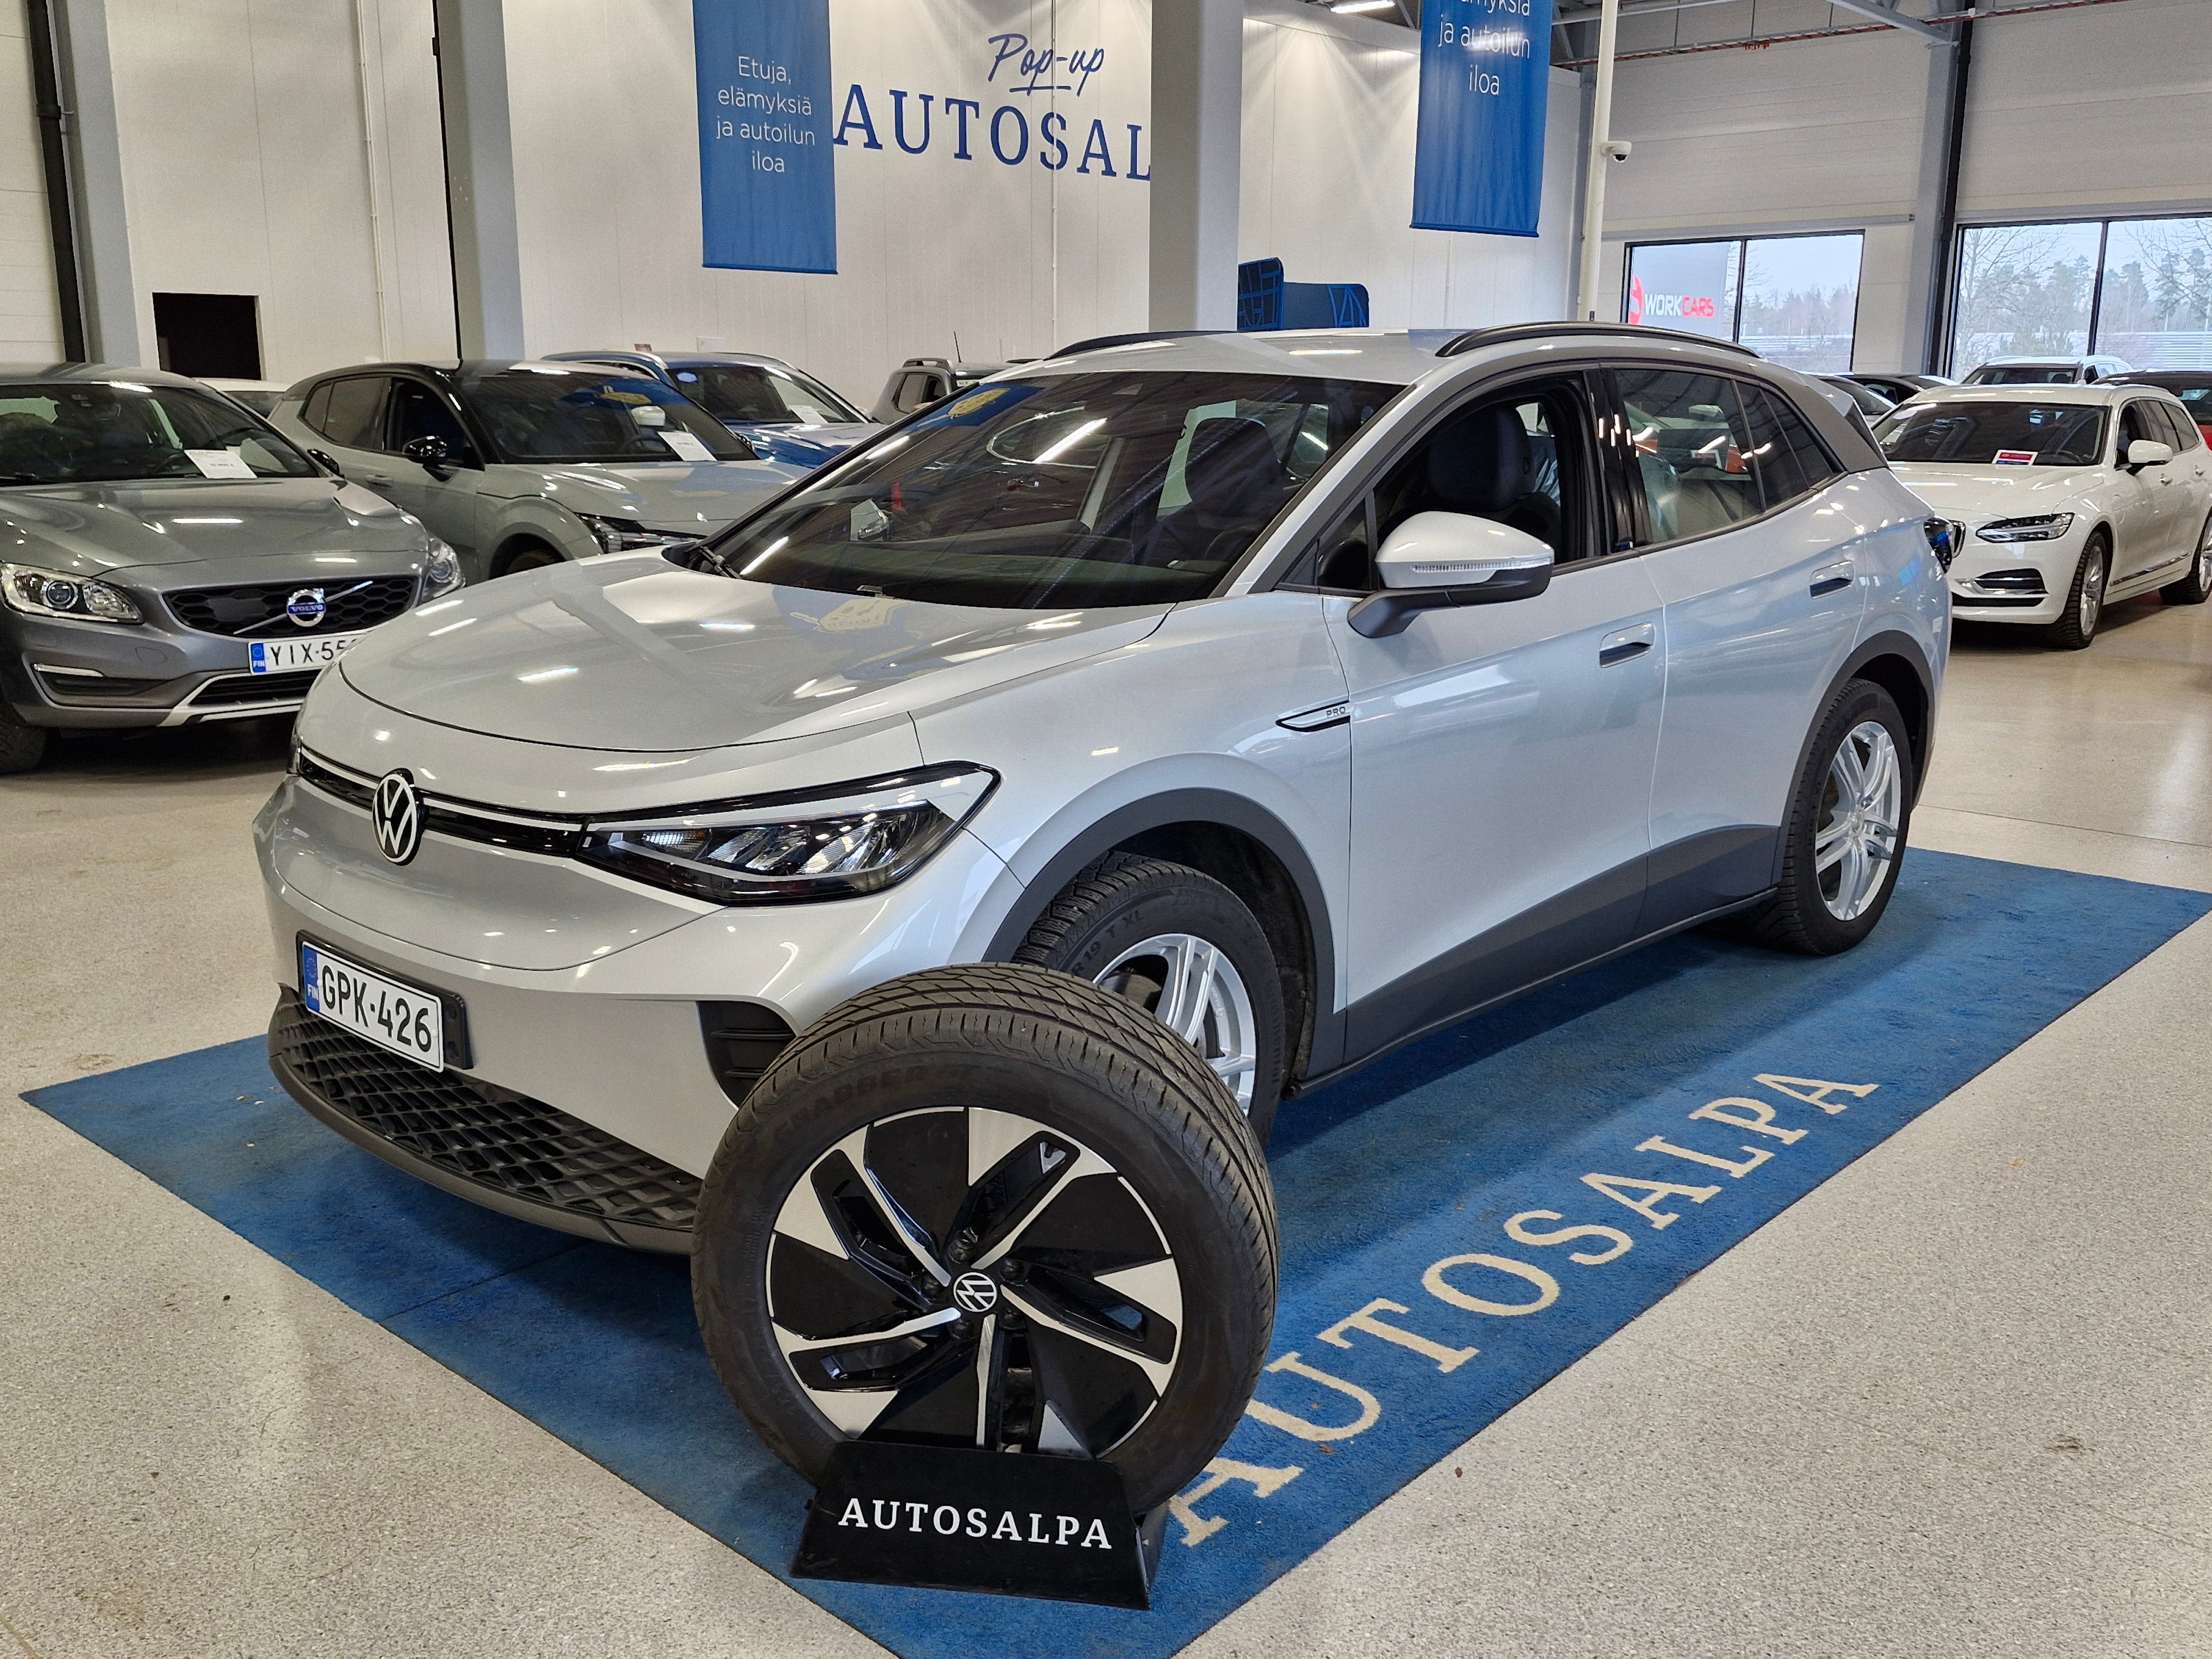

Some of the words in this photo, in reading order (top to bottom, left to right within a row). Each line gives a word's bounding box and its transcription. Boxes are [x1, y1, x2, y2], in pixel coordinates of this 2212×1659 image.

[1438, 14, 1454, 47] ja
[1460, 24, 1530, 59] autoilun
[738, 55, 791, 85] Etuja,
[988, 34, 1104, 96] Pop-up
[1469, 64, 1500, 96] iloa
[718, 85, 812, 116] elämyksiä
[716, 115, 733, 139] ja
[740, 122, 815, 146] autoilun
[833, 84, 1150, 181] AUTOSAL
[752, 150, 785, 173] iloa
[290, 604, 324, 612] VOLVO
[252, 660, 265, 668] FIN
[1326, 706, 1345, 718] PRO
[372, 774, 418, 863] VW
[1083, 941, 1101, 961] 19
[1105, 925, 1115, 939] T
[1121, 910, 1145, 928] XL
[307, 983, 320, 1001] FIN
[322, 965, 432, 1052] GPK-426
[953, 1272, 997, 1312] VW
[1168, 1072, 1880, 1547] AUTOSALPA
[838, 1498, 1112, 1549] AUTOSALPA
